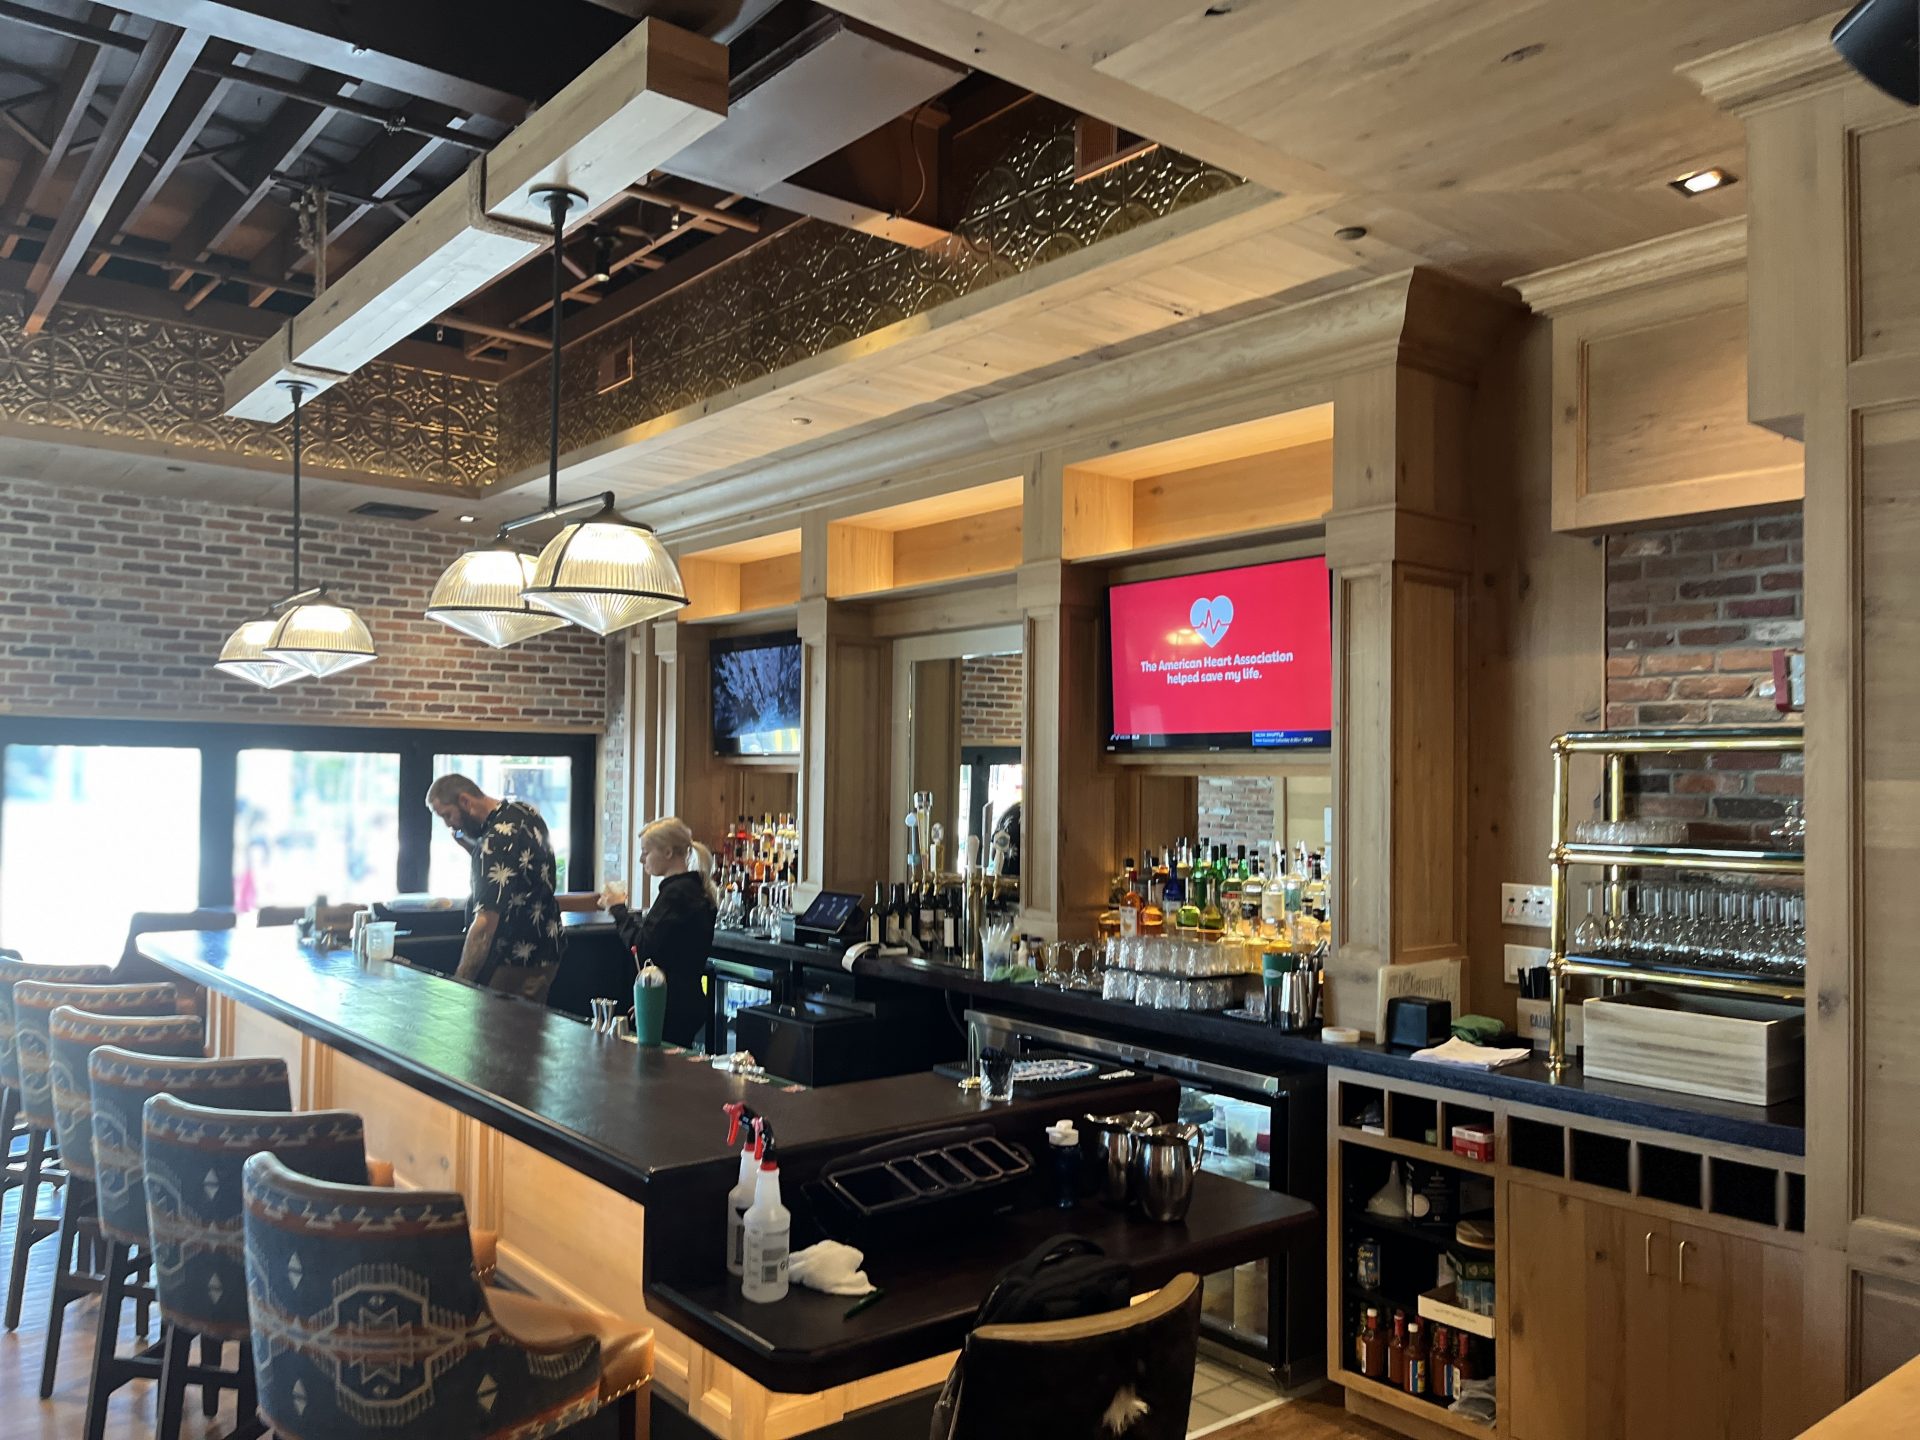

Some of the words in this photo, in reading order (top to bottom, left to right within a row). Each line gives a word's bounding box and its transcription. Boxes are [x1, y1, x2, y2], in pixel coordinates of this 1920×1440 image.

[1140, 661, 1157, 672] The
[1158, 658, 1202, 671] American
[1203, 656, 1232, 668] Heart
[1233, 650, 1294, 666] Association
[1167, 671, 1199, 686] helped
[1201, 672, 1223, 682] save
[1225, 672, 1241, 683] my
[1242, 668, 1262, 679] life.
